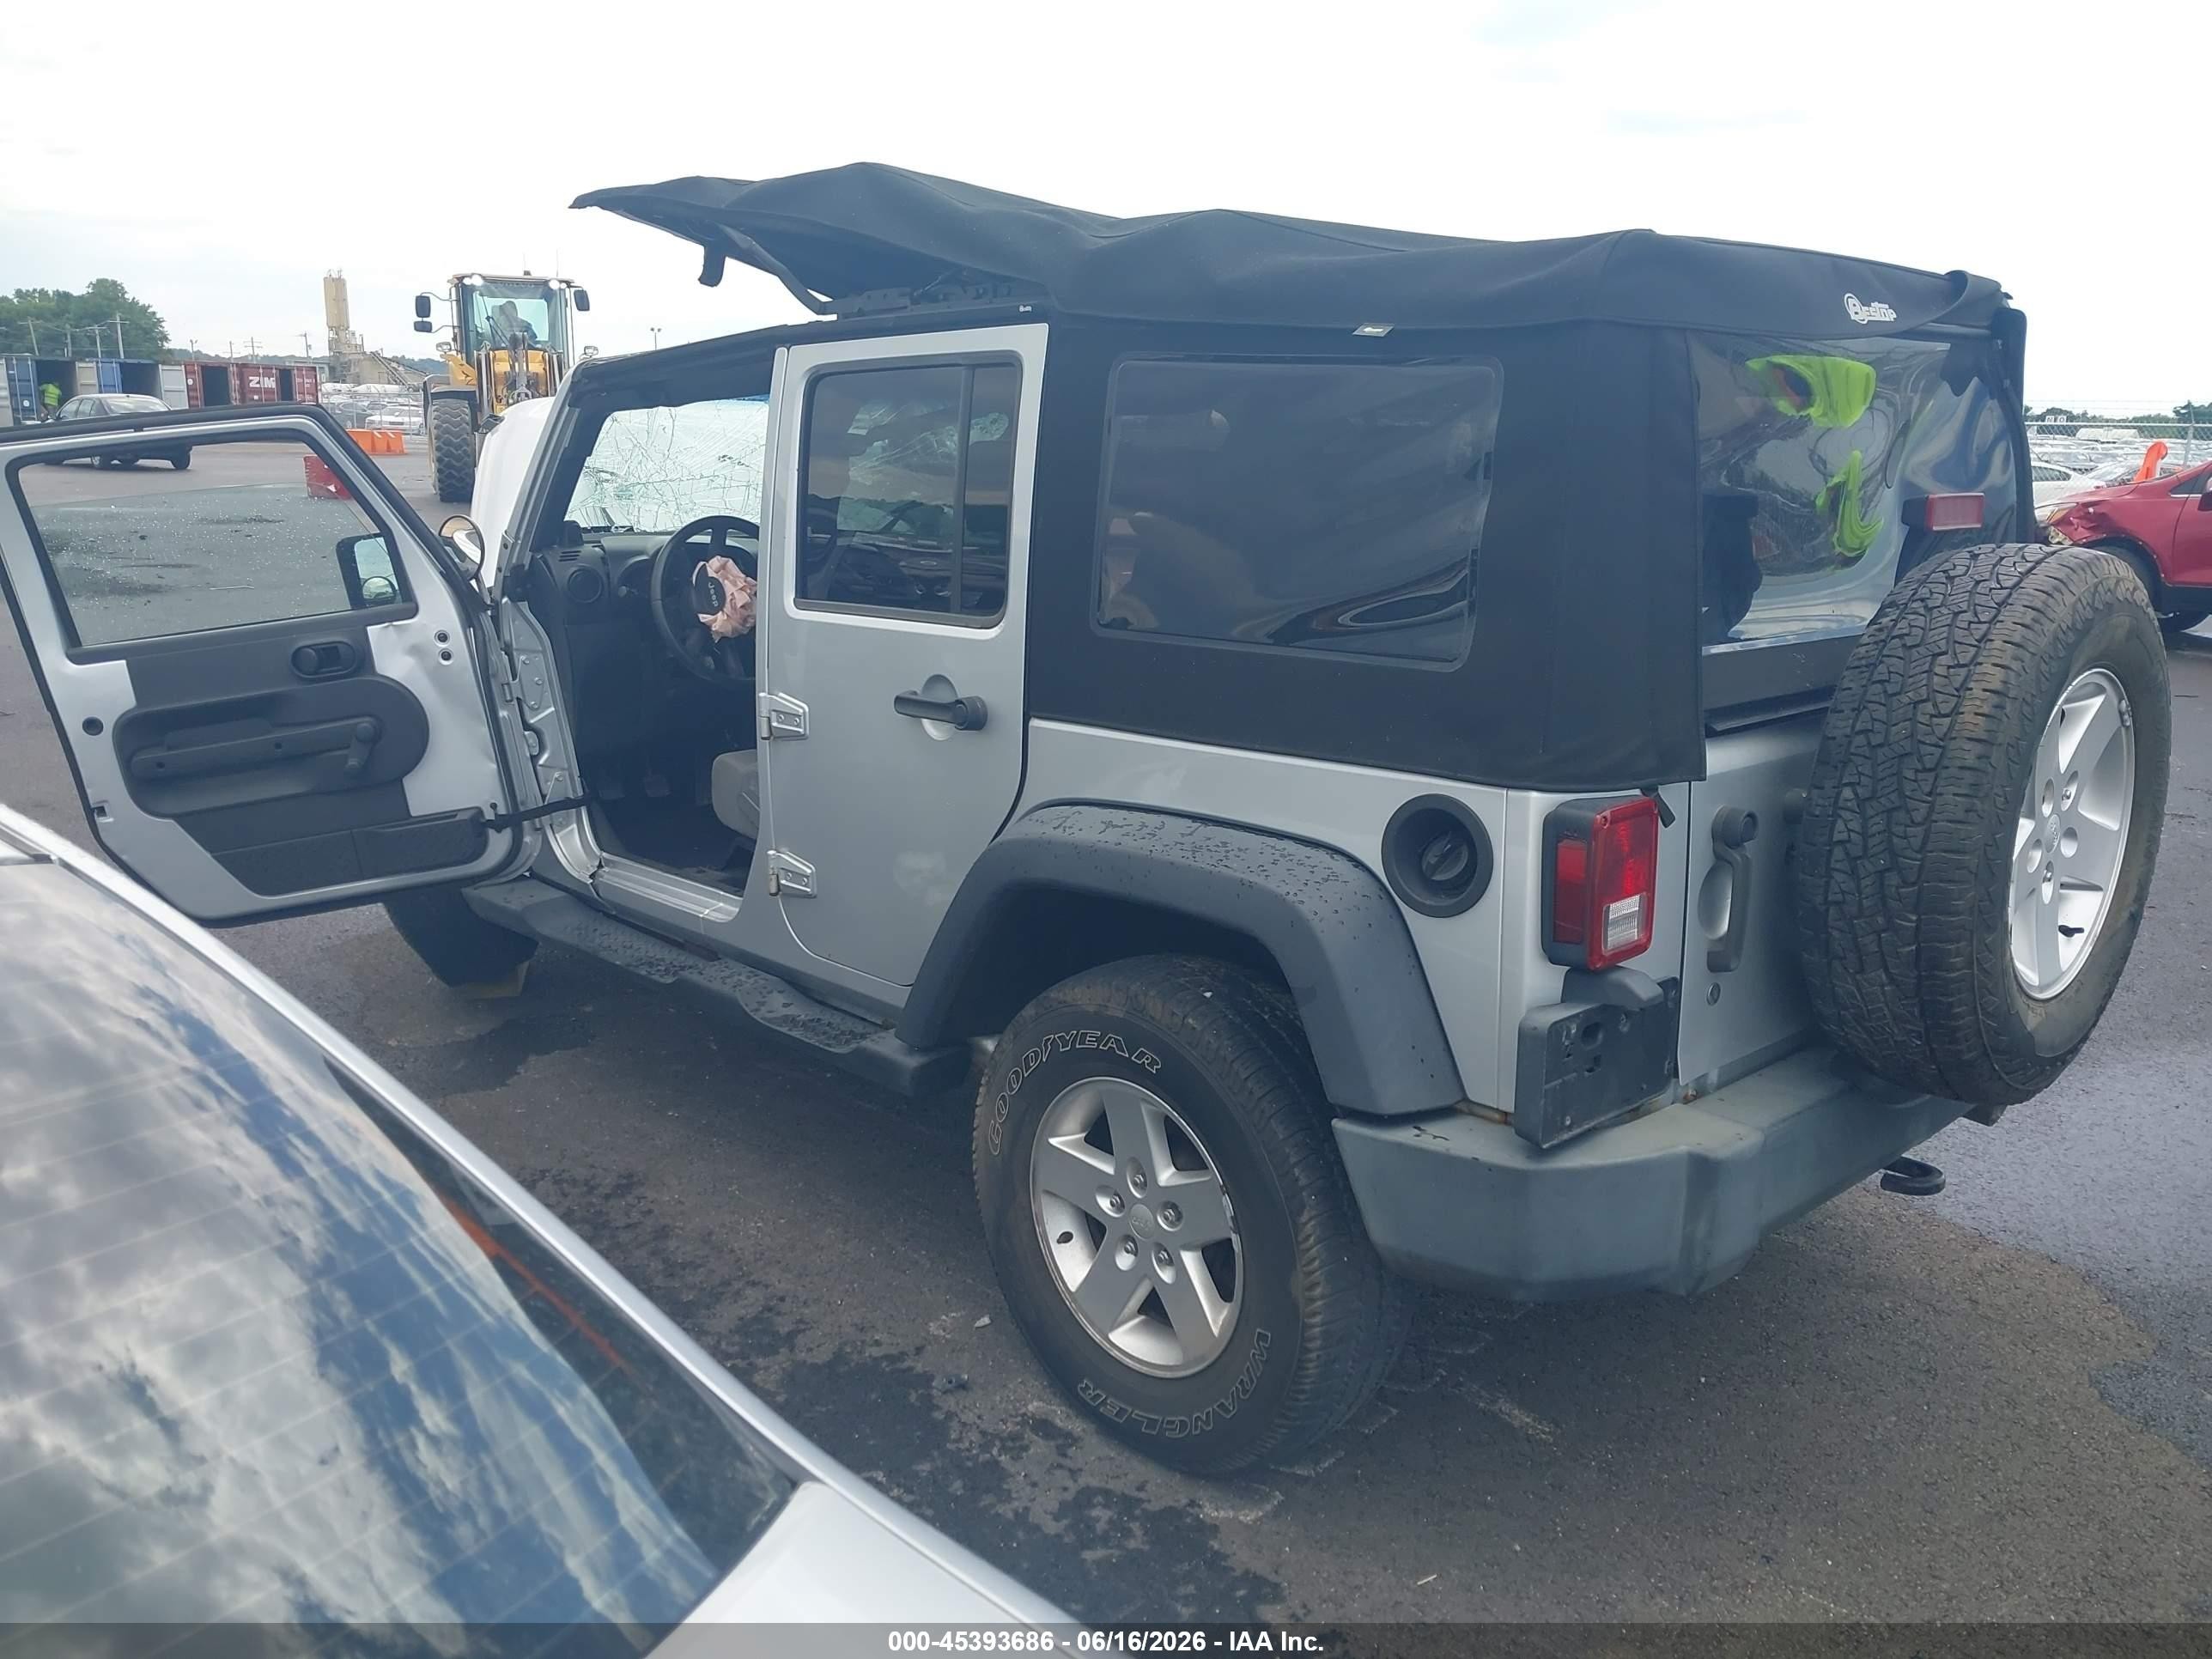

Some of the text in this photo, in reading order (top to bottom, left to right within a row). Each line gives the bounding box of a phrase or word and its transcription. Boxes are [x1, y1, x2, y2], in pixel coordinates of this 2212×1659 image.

[248, 376, 276, 389] ZIM
[708, 581, 719, 607] Jeep
[988, 1030, 1162, 1156] GOODYEAR
[1077, 1328, 1272, 1439] WRANGLER
